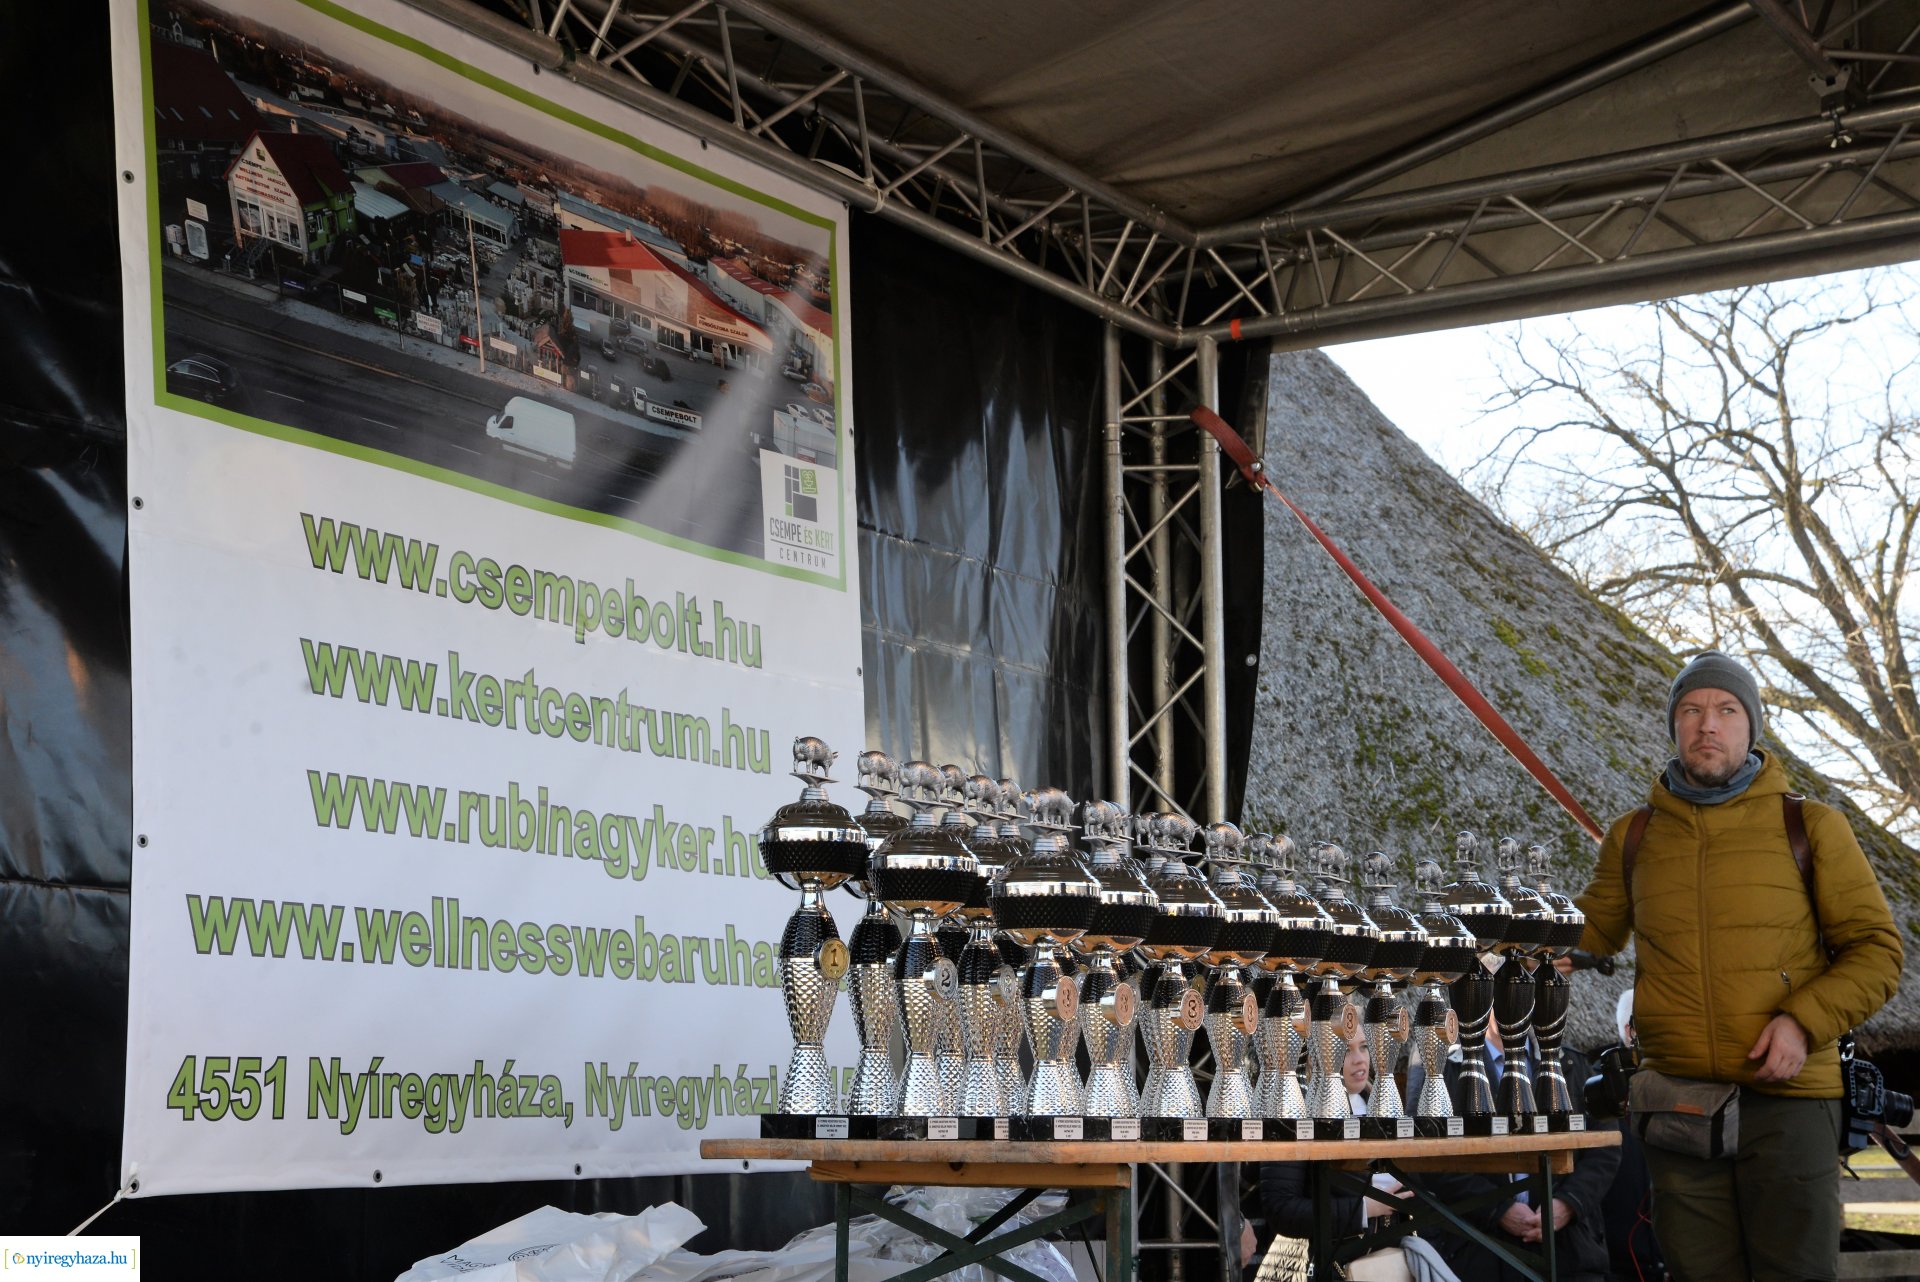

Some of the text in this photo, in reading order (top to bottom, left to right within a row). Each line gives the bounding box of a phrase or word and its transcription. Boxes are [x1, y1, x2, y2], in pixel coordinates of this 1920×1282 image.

[651, 406, 697, 424] CSEMPEBOLT
[769, 517, 802, 543] CSEMPE
[814, 528, 834, 552] KERT
[779, 547, 827, 569] CENTRUM
[300, 512, 763, 669] www.csempebolt.hu
[300, 637, 772, 774] www.kertcentrum.hu
[167, 1055, 287, 1121] 4551
[307, 1057, 573, 1135] Nyíregyháza,
[585, 1061, 778, 1131] Nyíregyházi
